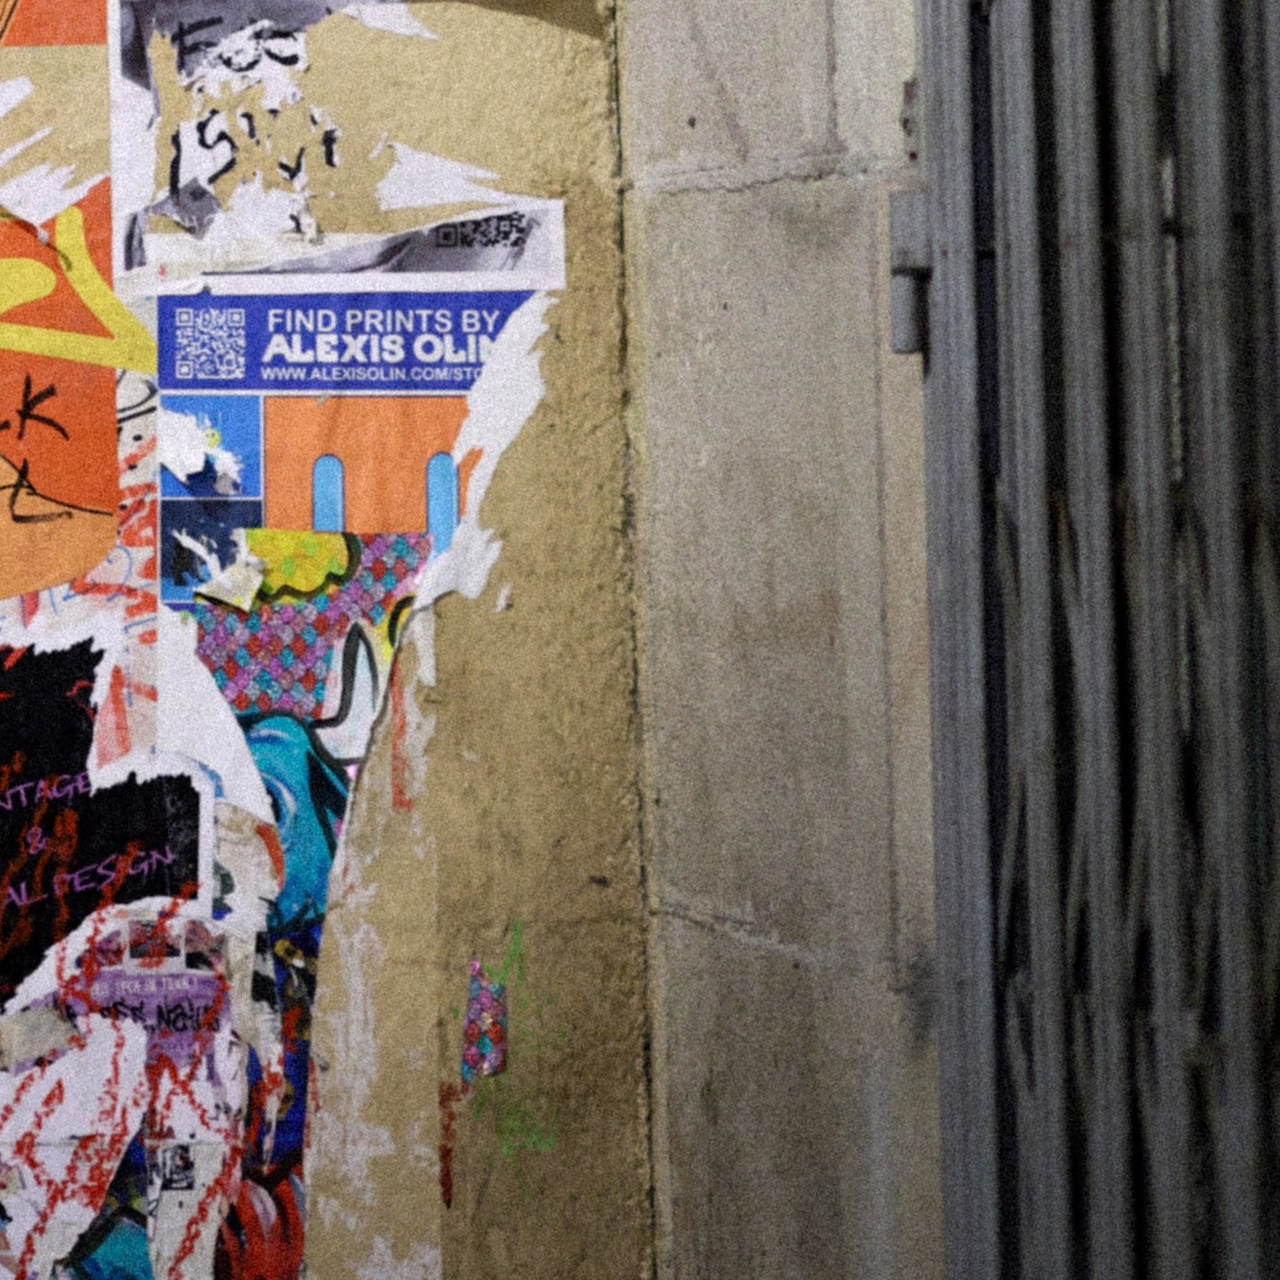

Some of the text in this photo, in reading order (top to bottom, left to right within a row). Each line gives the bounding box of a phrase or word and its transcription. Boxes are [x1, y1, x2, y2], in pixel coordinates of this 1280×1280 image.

[267, 308, 500, 333] FIND PRINTS BY
[261, 333, 405, 364] ALEXIS
